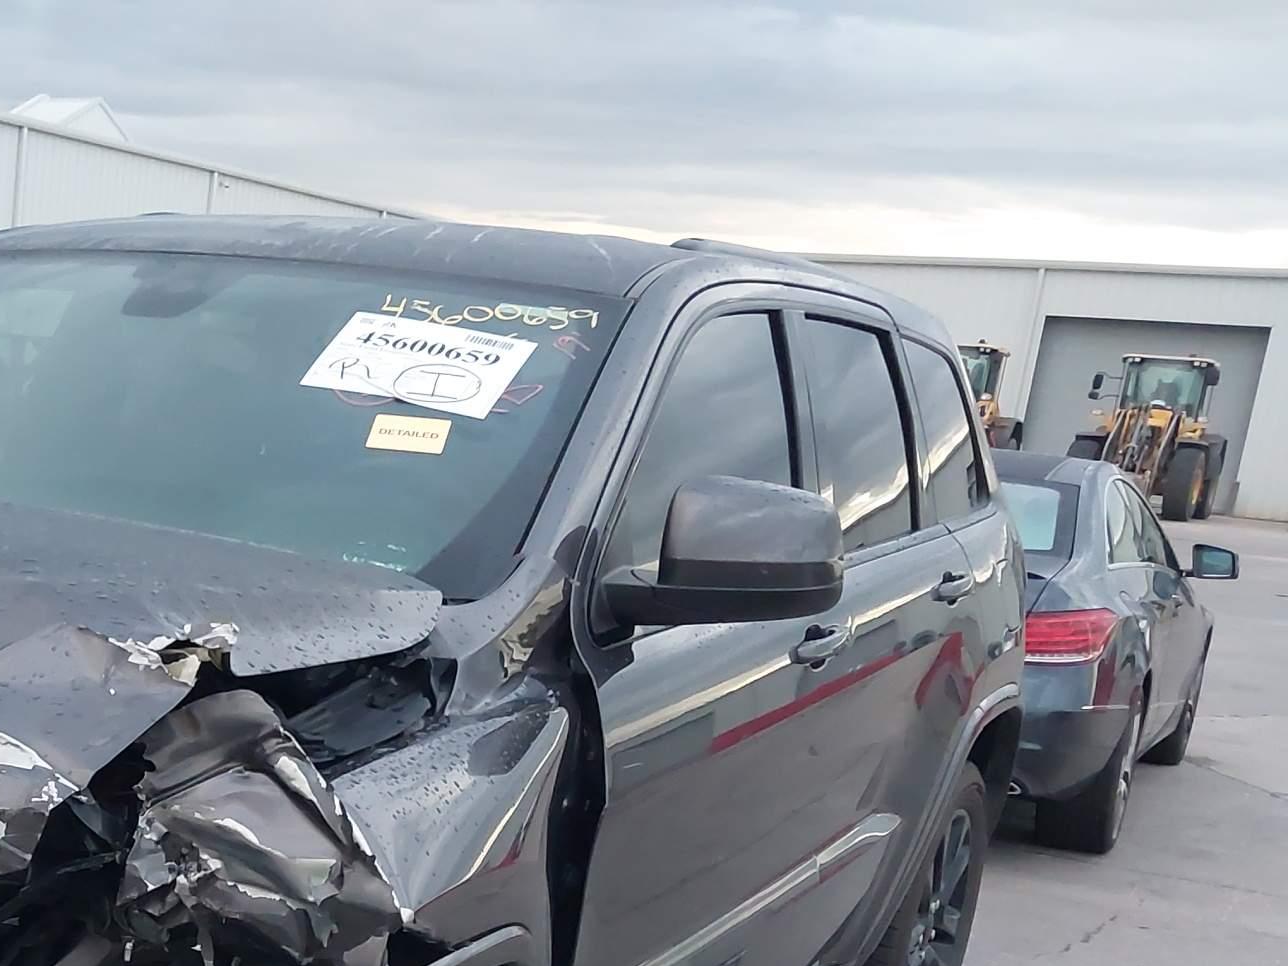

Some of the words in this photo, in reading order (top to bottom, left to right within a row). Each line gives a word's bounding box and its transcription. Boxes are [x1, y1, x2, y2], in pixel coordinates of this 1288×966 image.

[380, 294, 600, 330] 45600659
[356, 331, 501, 366] 45600659
[377, 427, 440, 440] DETAILED
